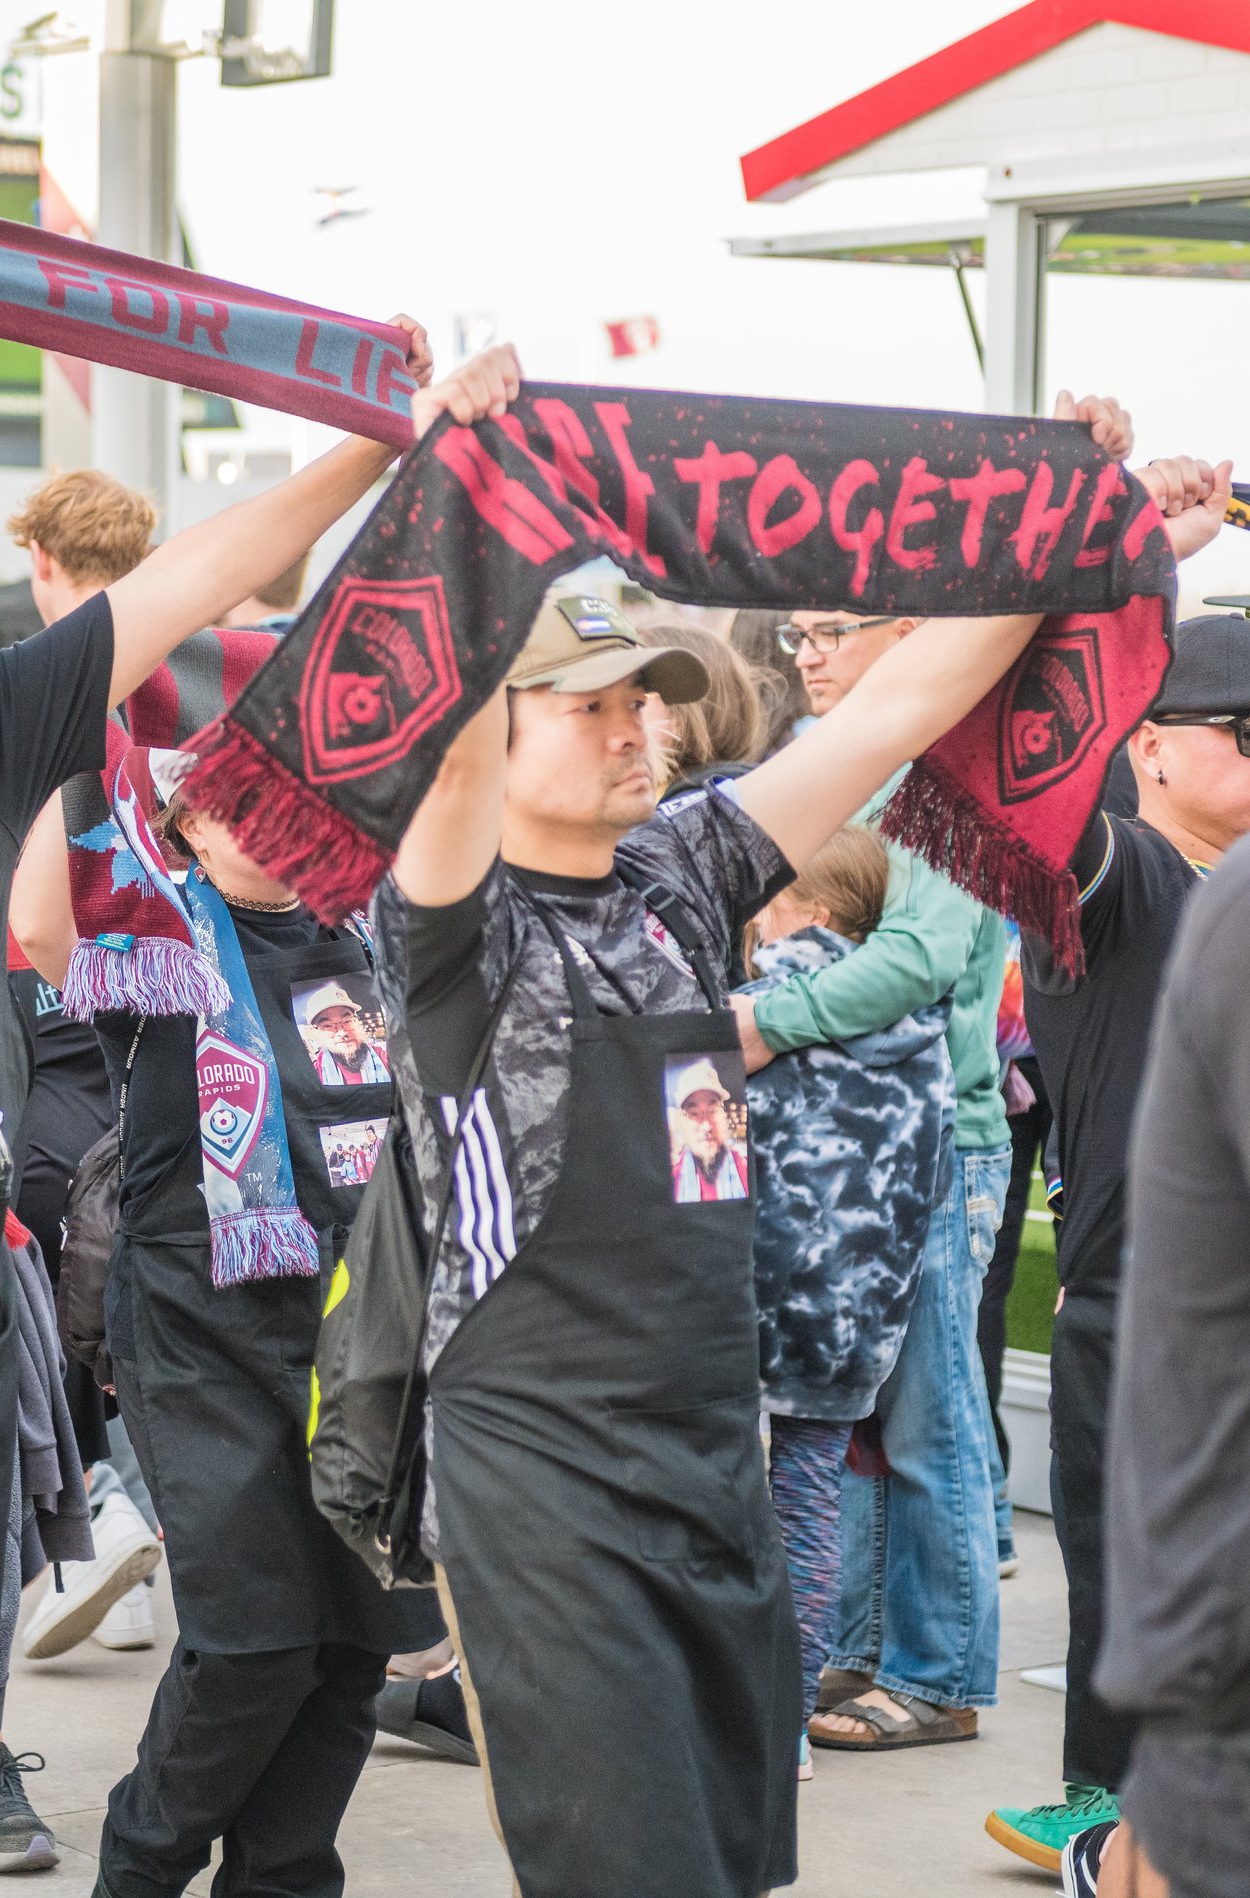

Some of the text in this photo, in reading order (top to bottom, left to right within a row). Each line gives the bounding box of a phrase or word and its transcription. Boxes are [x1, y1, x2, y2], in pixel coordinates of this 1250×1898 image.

[37, 259, 231, 356] FOR
[295, 319, 419, 405] LIF
[126, 1034, 140, 1070] ARMOUR
[196, 1063, 255, 1088] LORADO
[221, 1137, 234, 1145] 96
[246, 1173, 264, 1183] TM
